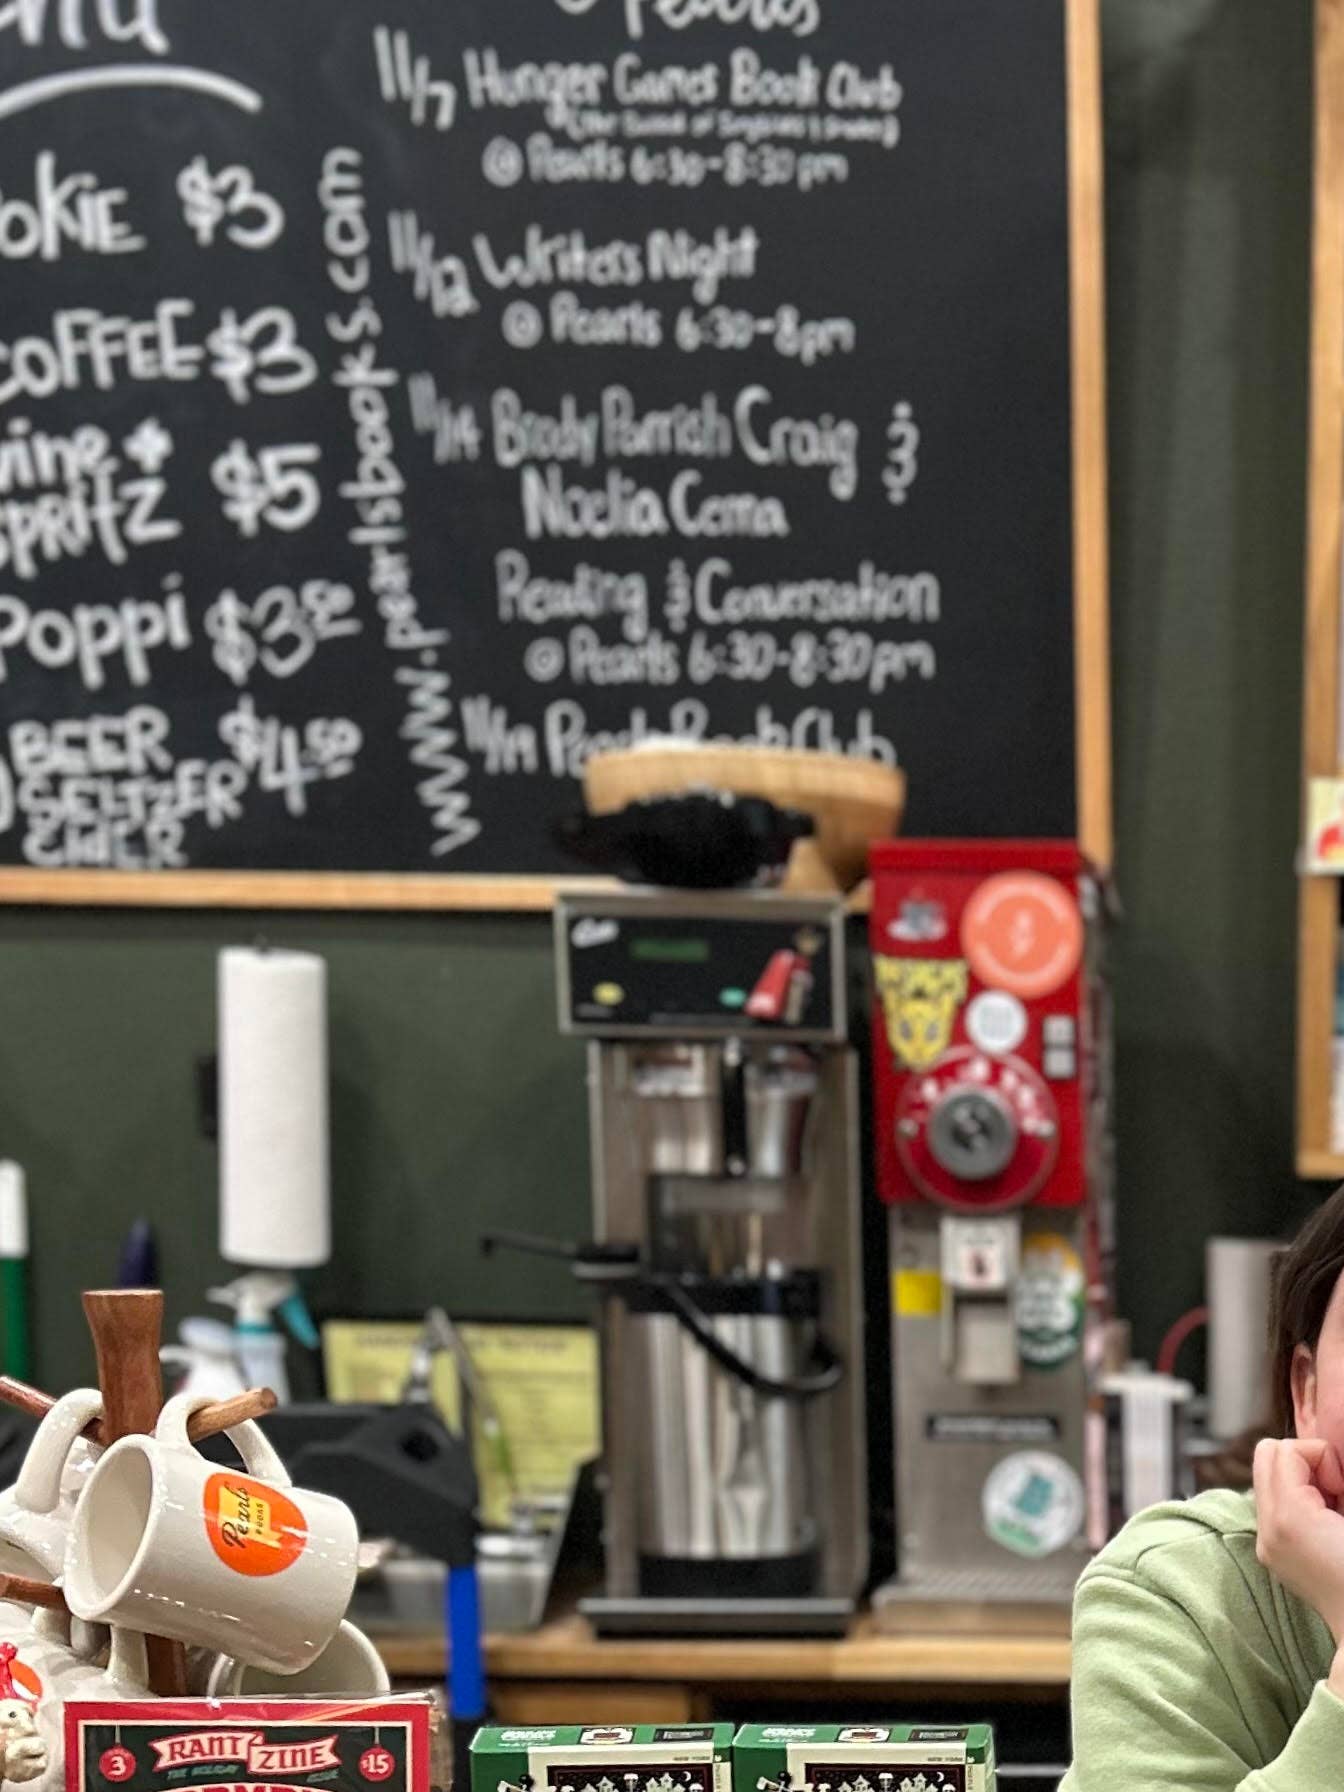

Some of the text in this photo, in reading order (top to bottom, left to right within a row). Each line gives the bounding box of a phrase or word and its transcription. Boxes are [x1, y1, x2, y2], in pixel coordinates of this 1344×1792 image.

[463, 47, 607, 129] Hunger
[730, 46, 820, 107] Book
[176, 156, 285, 249] $3
[647, 225, 760, 306] Night
[207, 307, 319, 402] $3
[734, 384, 860, 501] Craig
[210, 438, 321, 537] $5
[9, 705, 174, 775] BEER
[110, 1754, 127, 1776] 3
